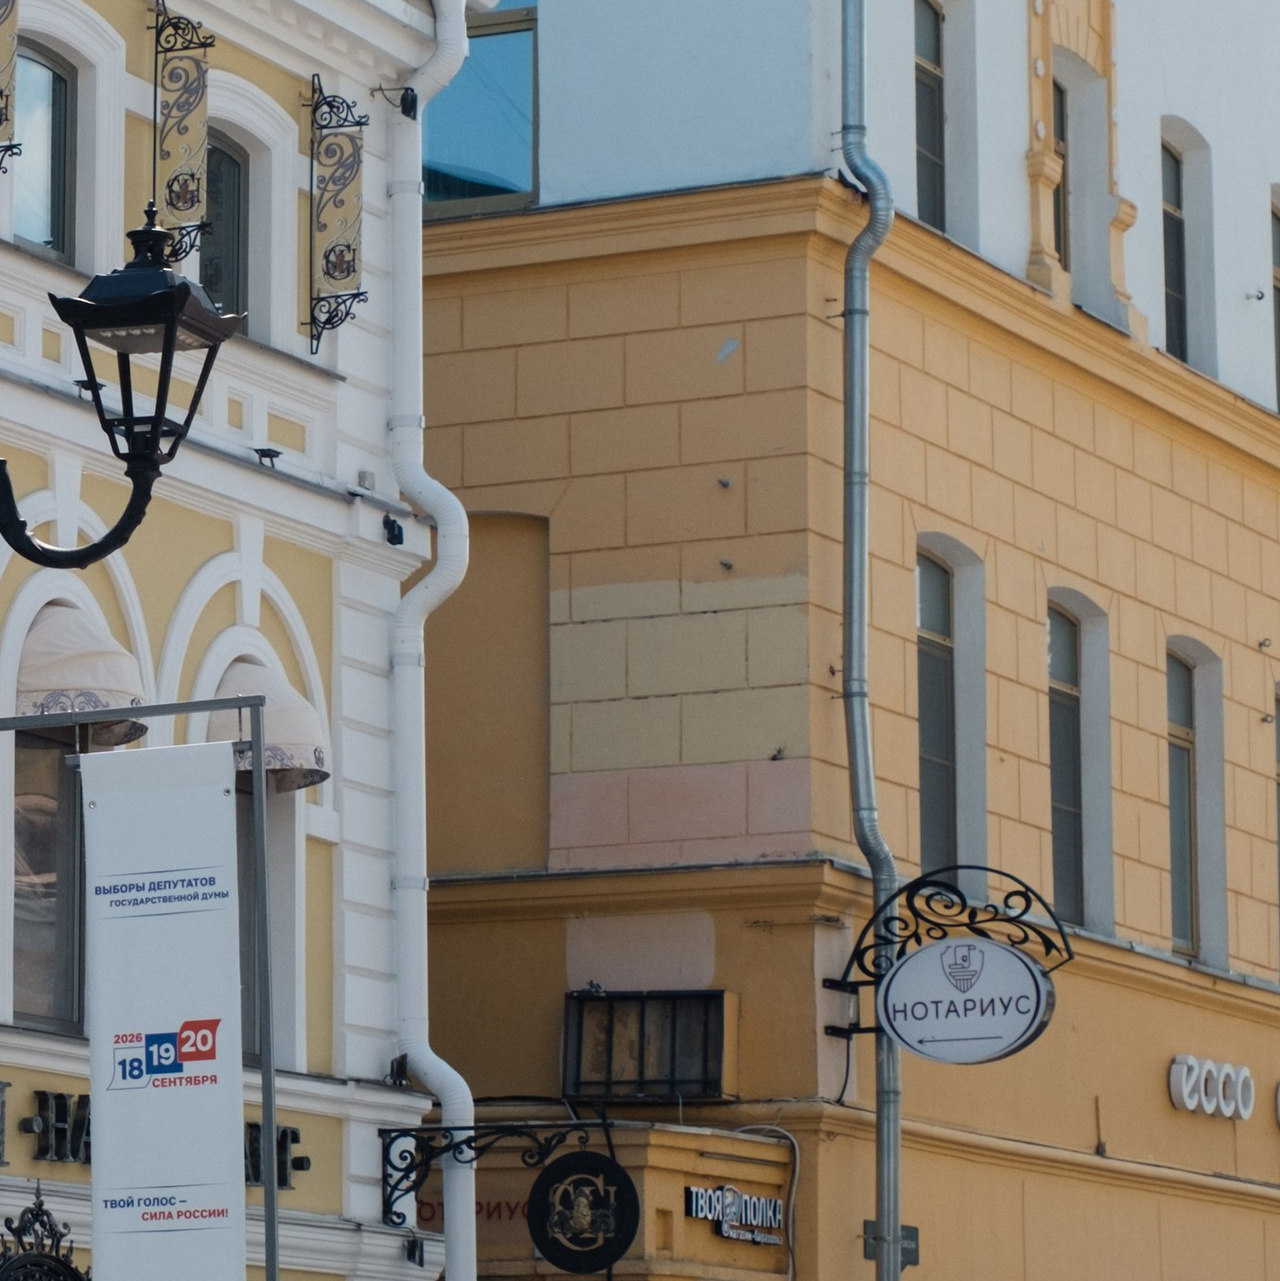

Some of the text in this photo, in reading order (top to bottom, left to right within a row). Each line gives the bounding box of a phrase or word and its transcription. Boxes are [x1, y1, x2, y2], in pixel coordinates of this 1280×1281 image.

[94, 876, 216, 895] ВЫБОРЫ ДЕПУТАТОВ
[109, 891, 229, 907] ГОСУДАРСТВЕННОЙ ДУМЫ
[892, 995, 1032, 1022] НОТАРИУС
[114, 1033, 143, 1044] 2026
[118, 1028, 214, 1081] 18 19 20
[152, 1074, 218, 1088] СЕНТЯБРЯ
[1169, 1054, 1255, 1120] ecco
[102, 1196, 135, 1209] ТВОЙ
[137, 1196, 177, 1208] ГОЛОС
[690, 1186, 784, 1229] ТВОЯ ПОЛКА
[141, 1208, 229, 1222] СИЛА РОССИИ!
